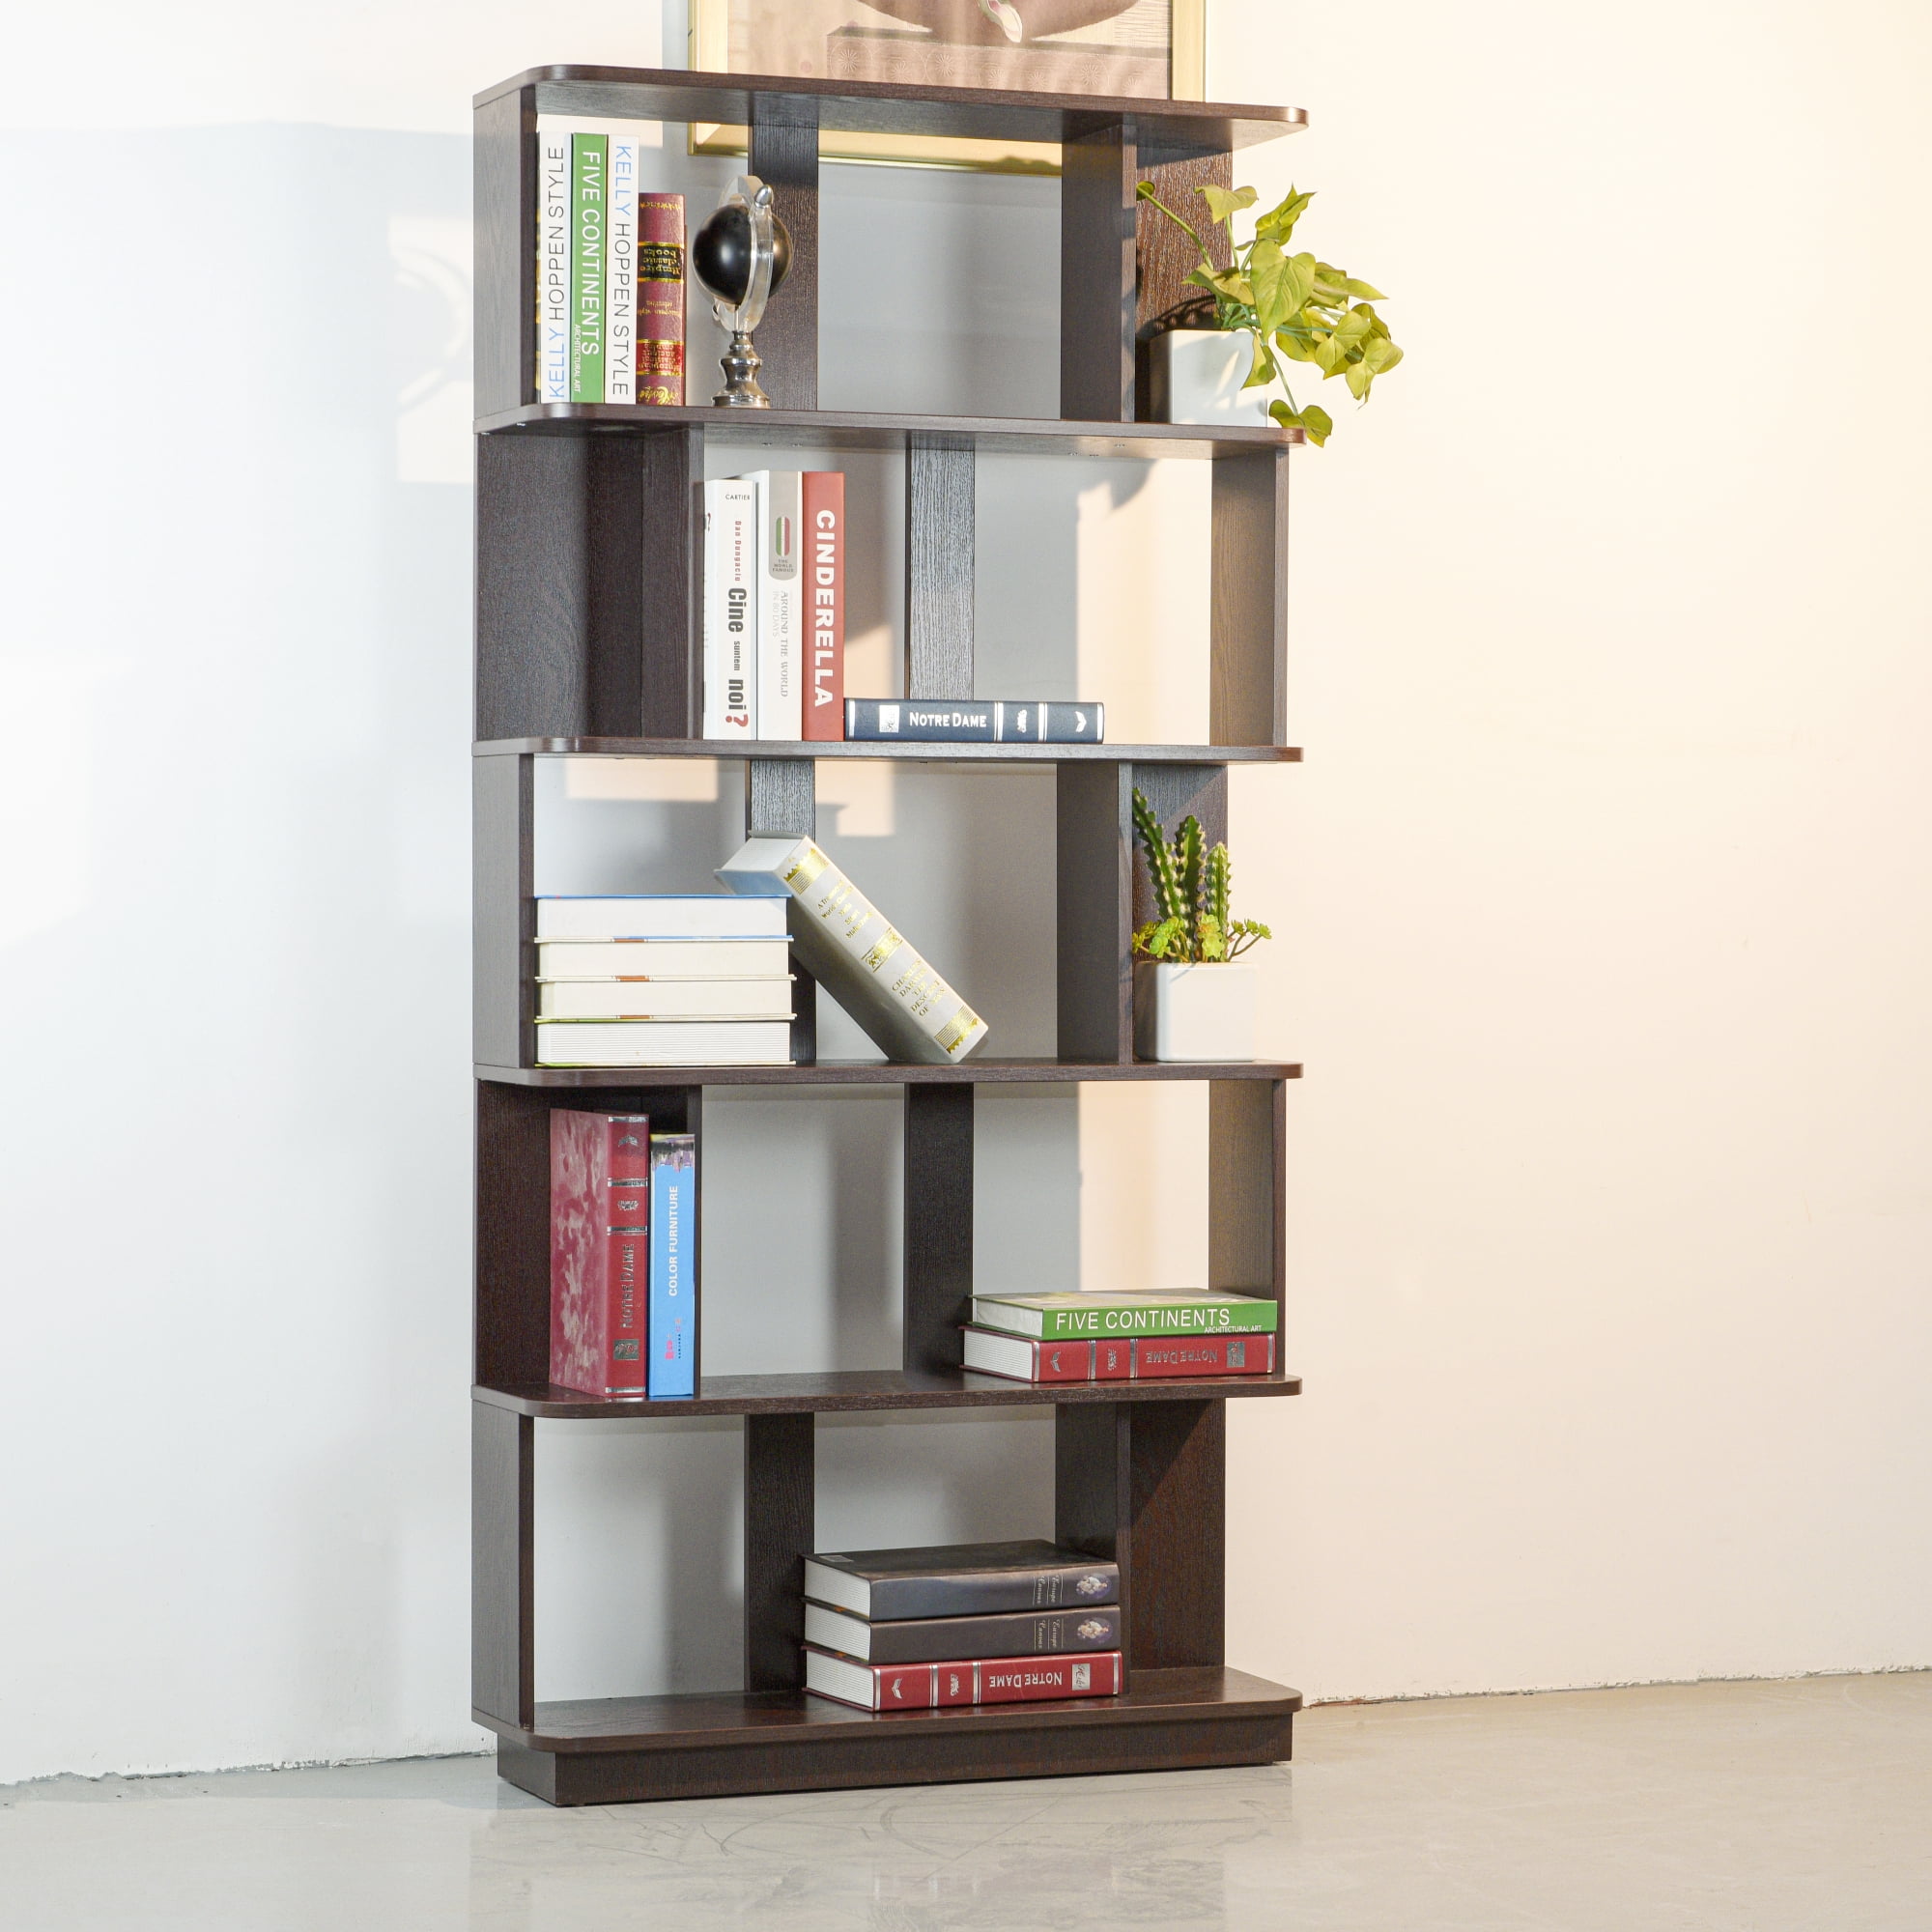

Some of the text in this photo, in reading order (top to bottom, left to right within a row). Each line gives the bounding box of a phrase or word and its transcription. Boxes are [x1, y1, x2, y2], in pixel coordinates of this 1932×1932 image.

[548, 147, 565, 398] KELLY HOPPEN STYLE
[582, 152, 600, 355] FIVE CONTINENTS
[612, 146, 632, 395] KELLY HOPPEN STYLE
[728, 587, 747, 633] Cine
[814, 509, 836, 707] CINDERELLA
[909, 712, 987, 728] NOTRE DAME
[917, 1004, 930, 1017] OF
[668, 1185, 678, 1296] COLOR FURNITURE
[620, 1243, 634, 1329] NOTRE DAME
[1056, 1308, 1231, 1331] FIVE CONTINENTS
[1204, 1325, 1250, 1334] ARCHITECTURAL
[1146, 1349, 1218, 1366] NOTRE DAME
[988, 1671, 1063, 1689] NOTRE DAME
